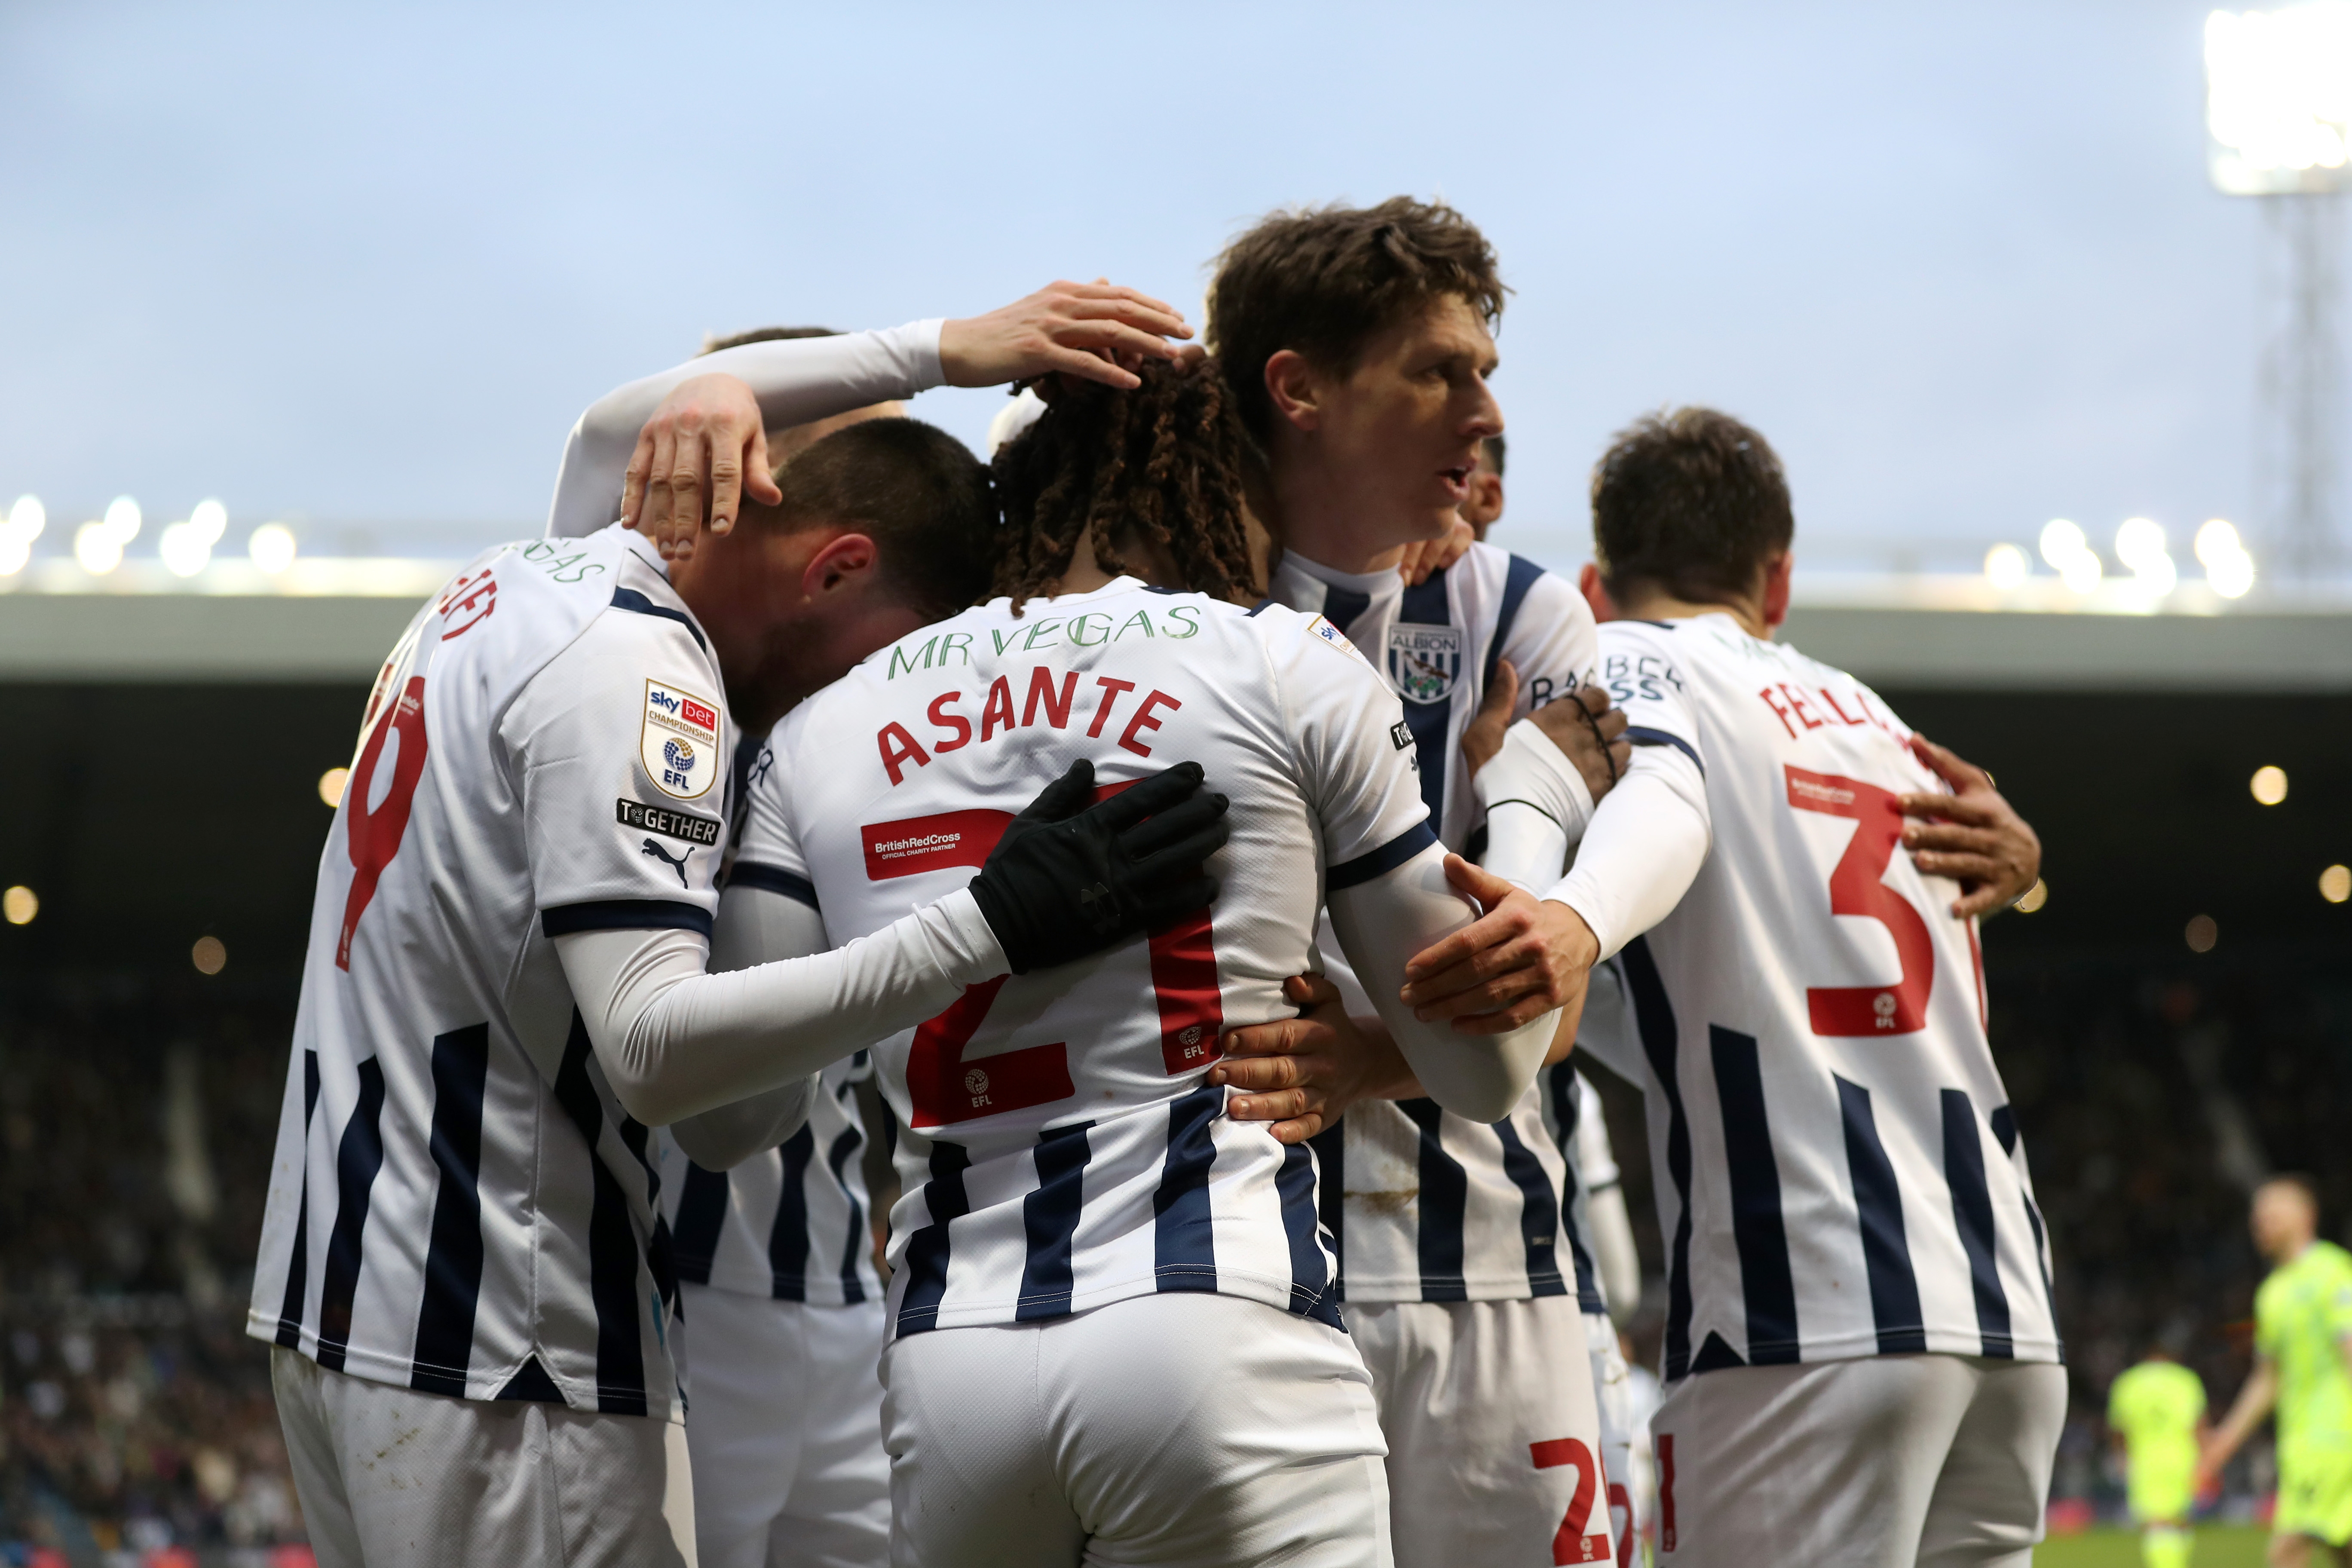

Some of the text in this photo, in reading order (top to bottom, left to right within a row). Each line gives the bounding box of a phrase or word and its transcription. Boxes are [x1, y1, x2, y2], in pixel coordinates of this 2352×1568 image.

[888, 606, 1200, 680] MR VEGAS
[1393, 635, 1457, 649] ALBION
[651, 692, 712, 726] sky bet
[649, 710, 714, 741] CHAMPIONSHIP
[877, 666, 1181, 787] ASANTE
[664, 769, 689, 789] EFL
[335, 671, 428, 973] 9
[882, 843, 956, 860] OFFICIAL CHARITY PARTNER
[1784, 763, 1934, 1037] 3
[1184, 1045, 1204, 1059] EFL
[972, 1095, 992, 1108] EFL
[1529, 1438, 1612, 1567] 2
